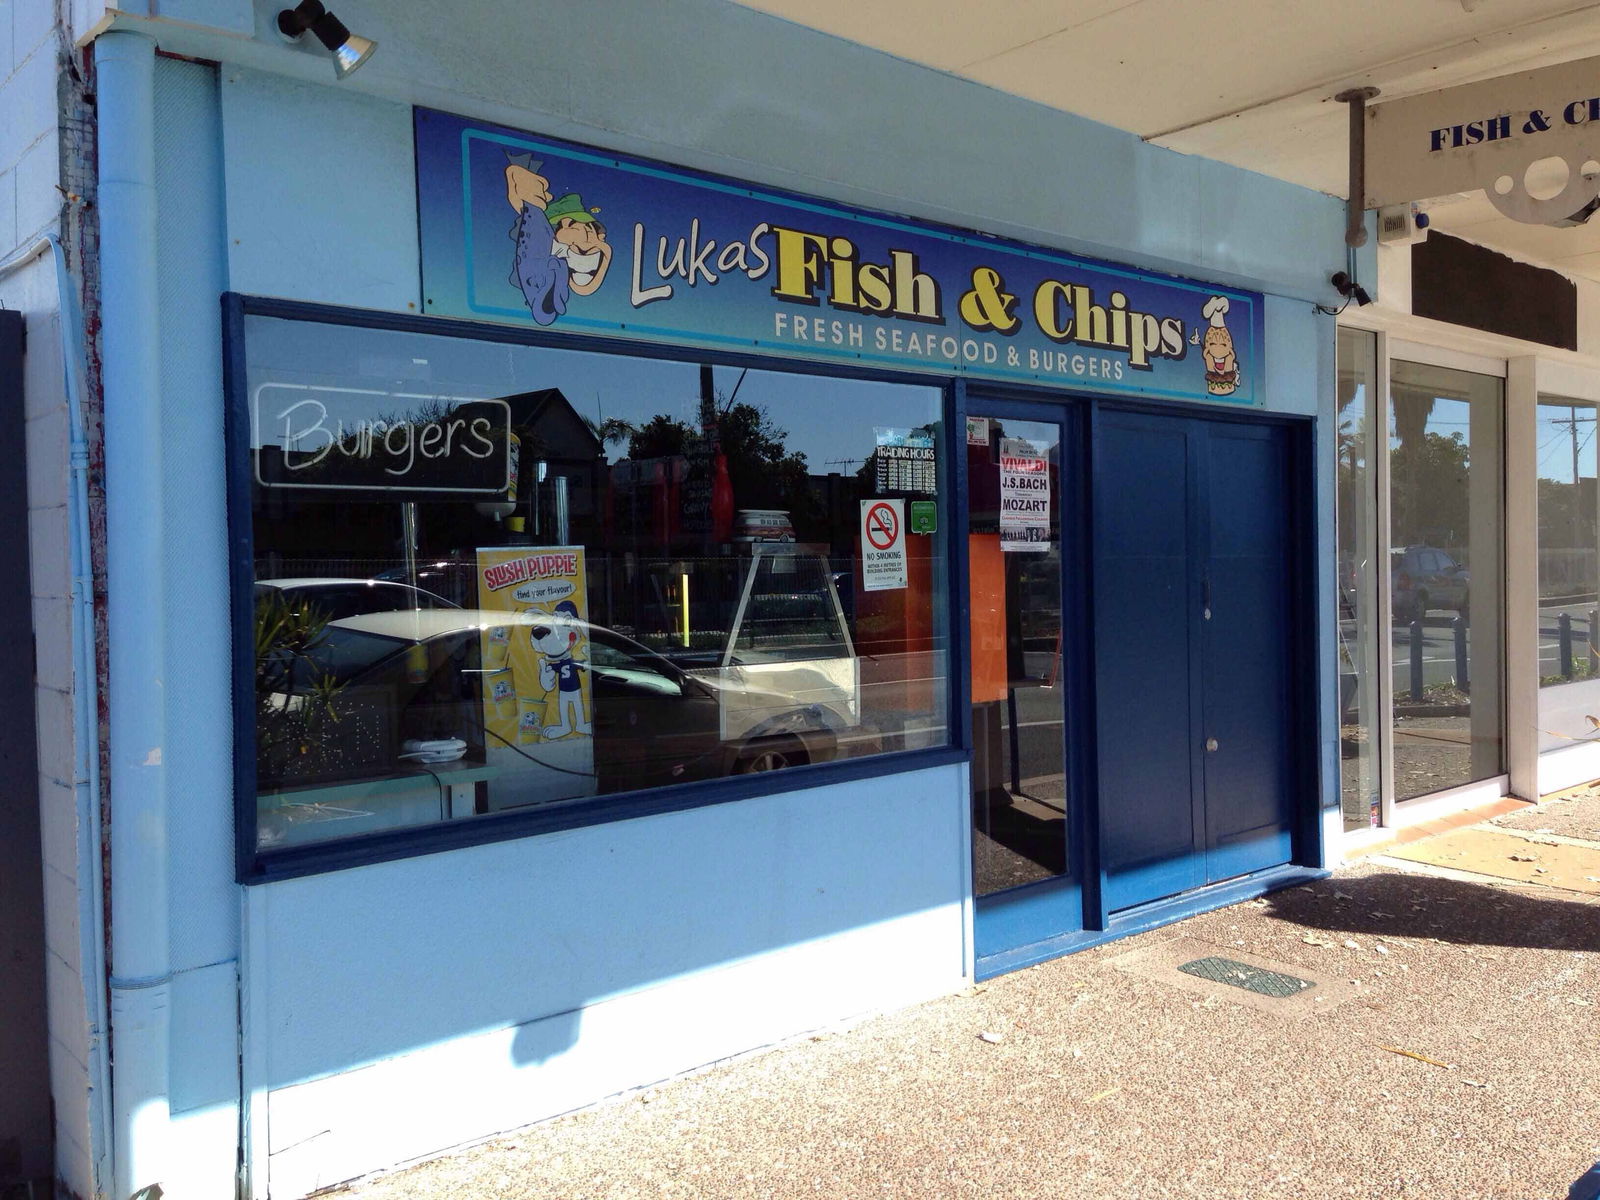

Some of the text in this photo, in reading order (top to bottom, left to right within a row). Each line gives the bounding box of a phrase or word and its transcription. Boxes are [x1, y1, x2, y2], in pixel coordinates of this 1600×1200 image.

[1429, 115, 1512, 152] FISH
[1522, 109, 1551, 134] &
[772, 227, 943, 322] Fish
[960, 267, 1019, 333] &
[1035, 279, 1185, 369] Chips
[775, 313, 1123, 380] FRESH SEAFOOD & BURGERS
[277, 400, 494, 475] Burgers
[877, 446, 934, 460] TRADING HOURS
[1001, 457, 1047, 472] VIVALDI
[1002, 477, 1047, 490] J.S.BACH
[1002, 499, 1047, 512] MOZART
[876, 551, 901, 560] SMOKING
[484, 559, 526, 589] SLUSH
